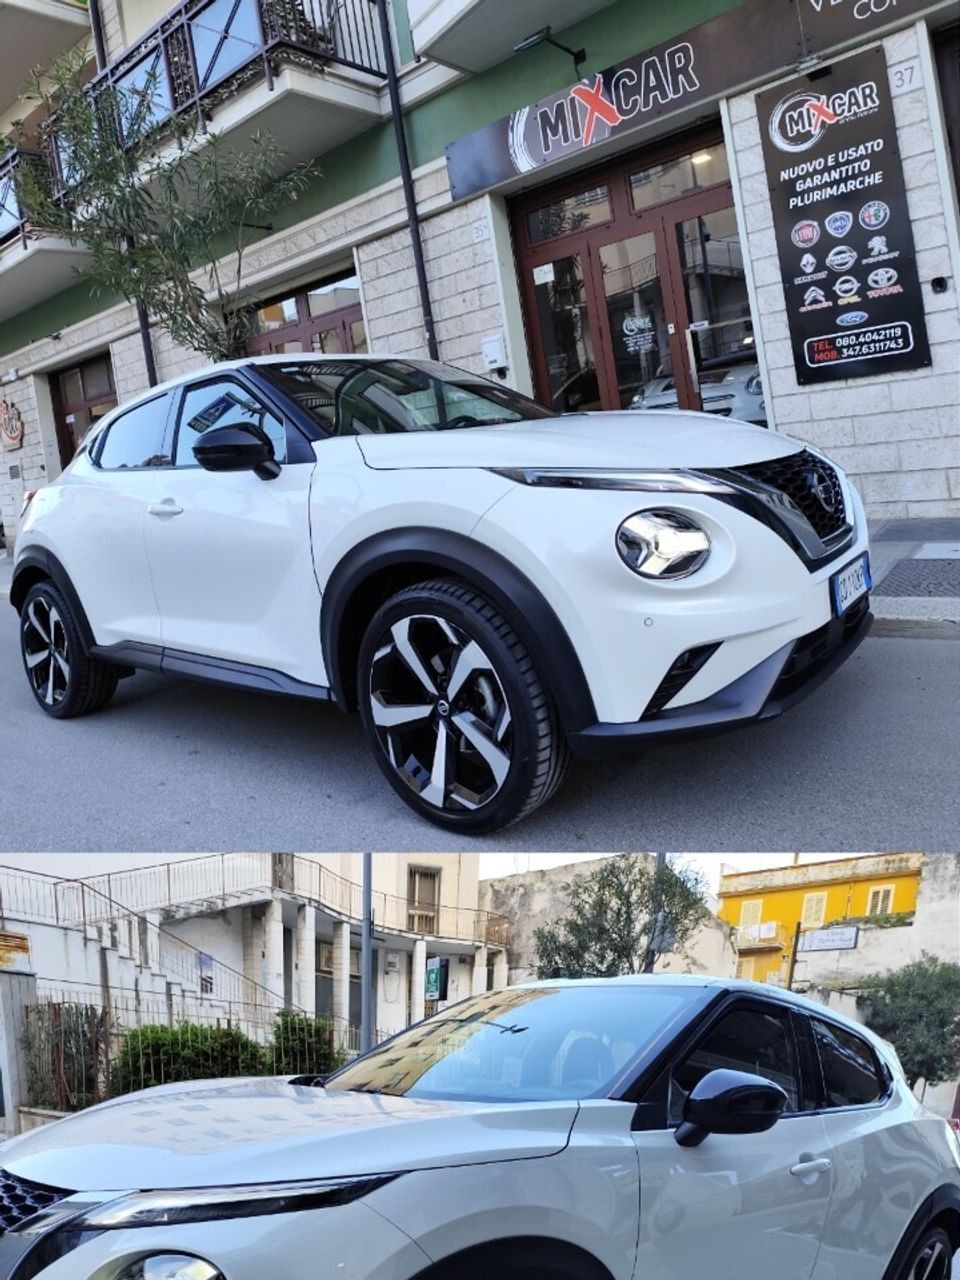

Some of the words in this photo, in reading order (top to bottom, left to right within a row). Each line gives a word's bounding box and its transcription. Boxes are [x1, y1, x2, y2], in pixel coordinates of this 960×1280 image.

[853, 0, 897, 19] CO
[894, 66, 915, 88] 37
[537, 42, 700, 154] MIXCAR
[786, 81, 879, 137] MIXCAR
[780, 158, 824, 182] NUOVO
[827, 154, 836, 167] E
[838, 138, 884, 163] USATO
[796, 159, 871, 191] GARANTITO
[789, 171, 884, 209] PLURIMARCHE
[813, 341, 834, 352] TEL.
[835, 327, 902, 348] 080.4042119
[814, 350, 840, 362] MOB.
[841, 339, 904, 358] 347.6311743
